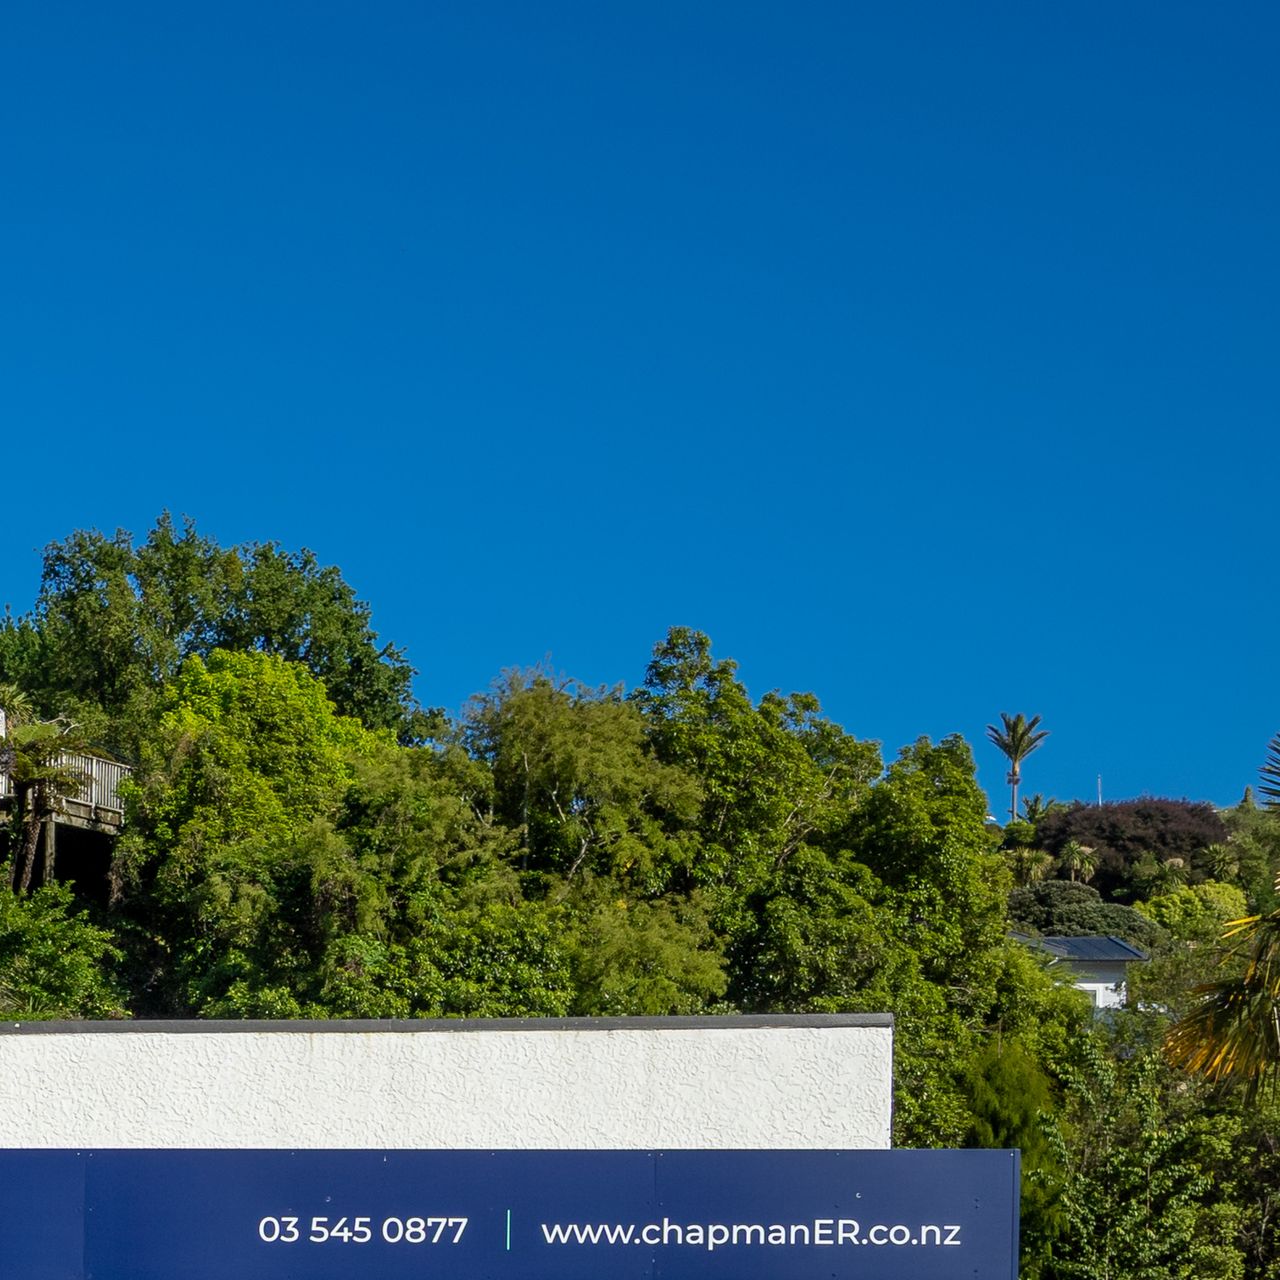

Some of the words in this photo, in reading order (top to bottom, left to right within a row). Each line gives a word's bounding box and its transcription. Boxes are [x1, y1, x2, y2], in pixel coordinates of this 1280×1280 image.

[258, 1216, 300, 1243] 03
[309, 1217, 372, 1243] 545
[382, 1217, 468, 1243] 0877
[541, 1218, 962, 1250] www.chapmanER.co.nz
